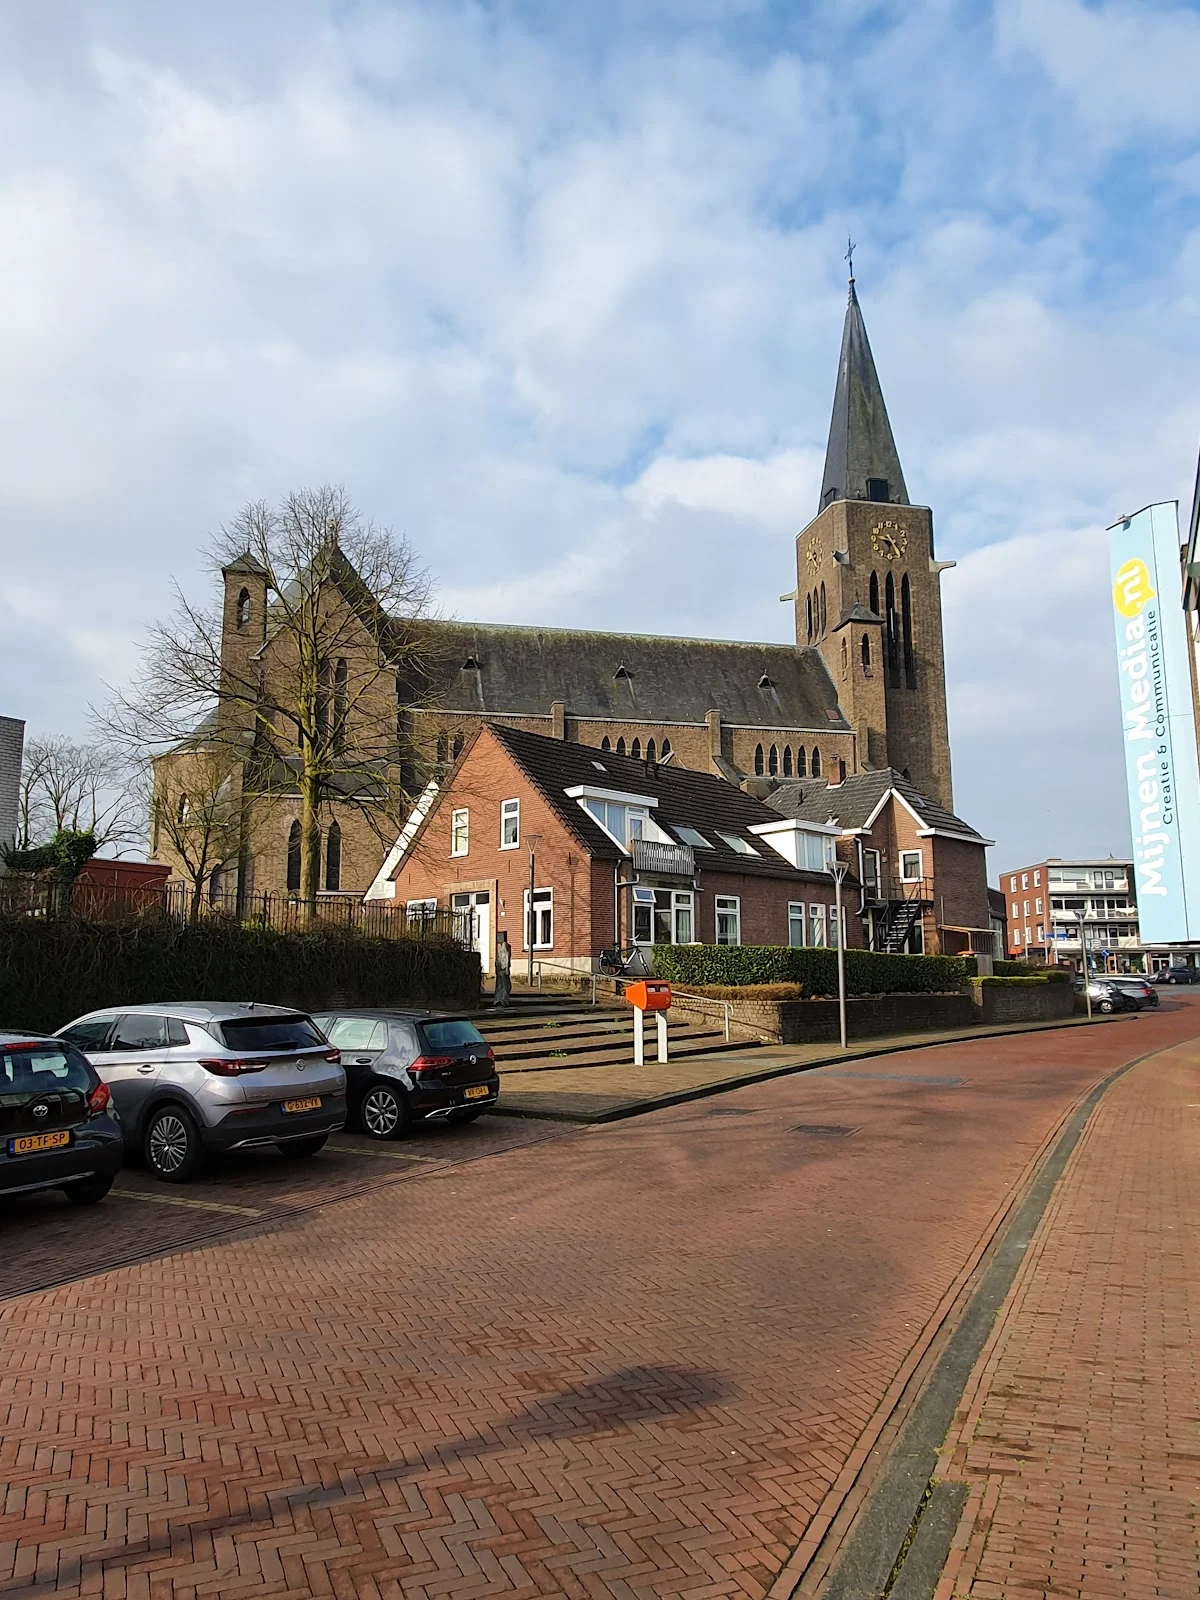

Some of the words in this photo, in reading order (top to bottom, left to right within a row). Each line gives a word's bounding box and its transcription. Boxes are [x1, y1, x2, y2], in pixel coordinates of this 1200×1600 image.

[1147, 610, 1166, 737] Communicatie
[1156, 744, 1167, 755] &
[1135, 749, 1170, 897] Mijnen
[1159, 761, 1173, 825] Creatie
[19, 1132, 66, 1150] 03-TF-SP
